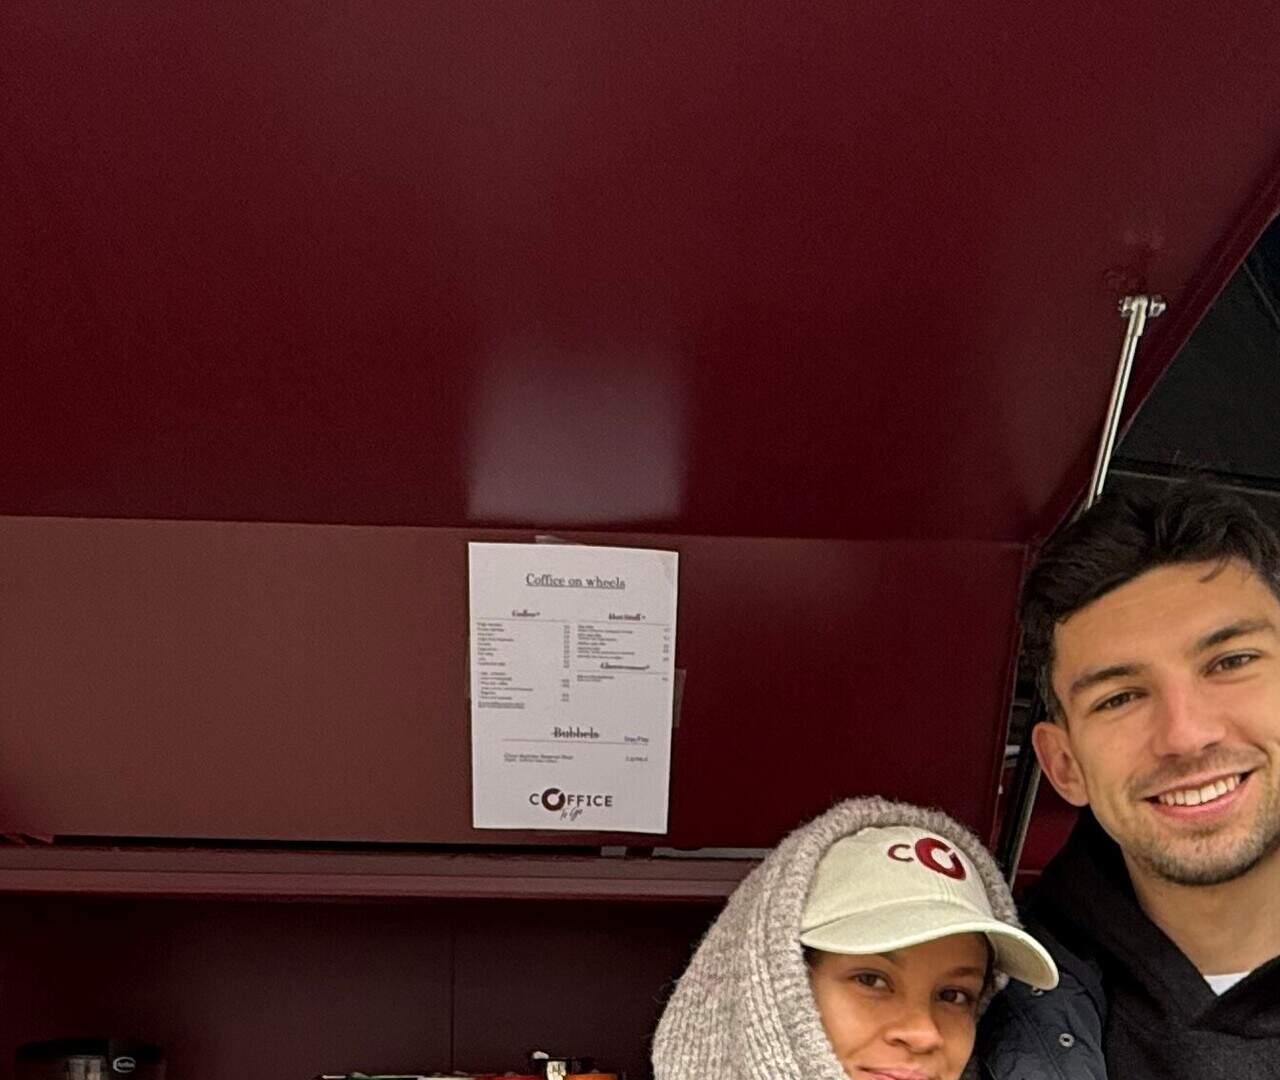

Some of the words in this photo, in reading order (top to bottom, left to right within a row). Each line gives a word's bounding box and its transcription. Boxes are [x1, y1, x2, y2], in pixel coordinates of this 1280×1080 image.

[568, 579, 582, 587] on
[586, 577, 625, 590] wheels
[529, 787, 613, 811] COFFICE
